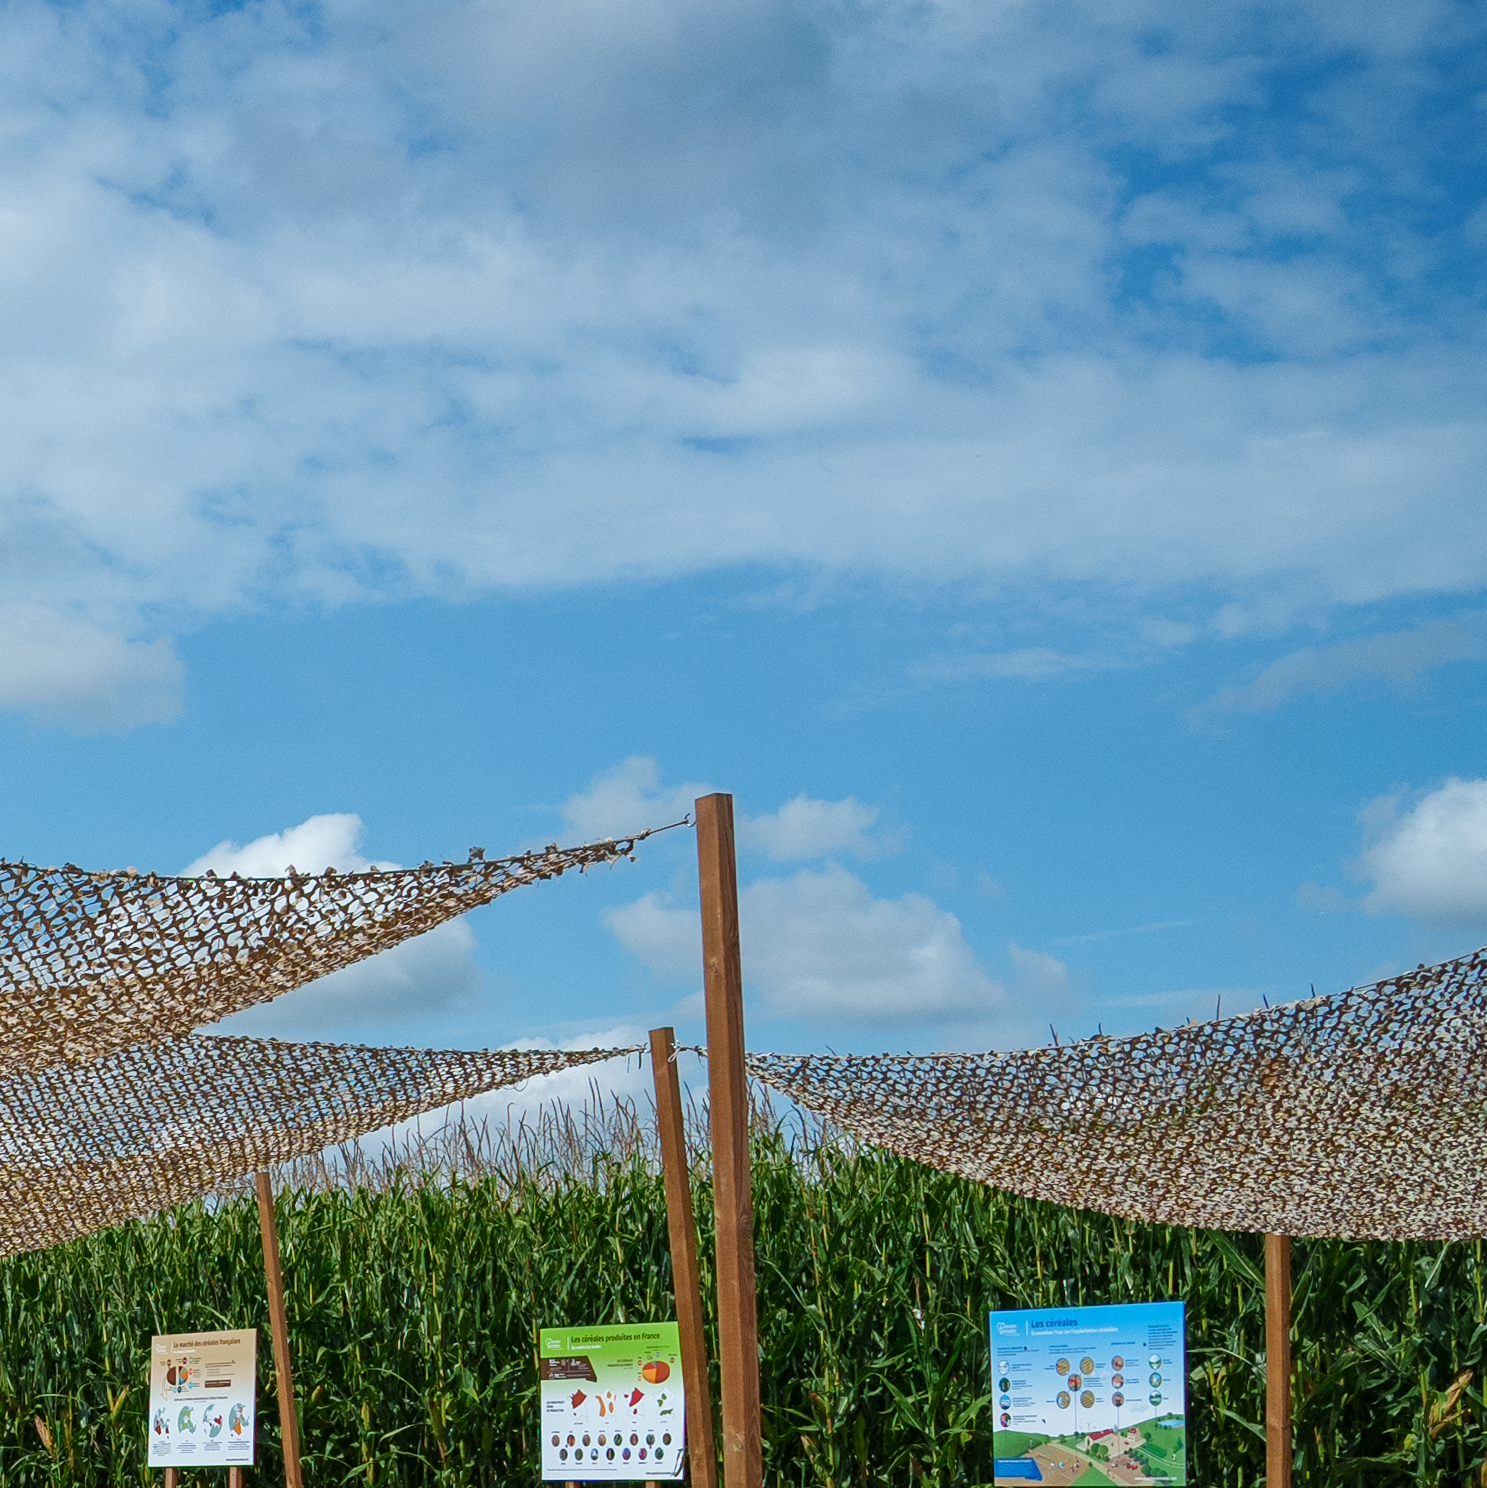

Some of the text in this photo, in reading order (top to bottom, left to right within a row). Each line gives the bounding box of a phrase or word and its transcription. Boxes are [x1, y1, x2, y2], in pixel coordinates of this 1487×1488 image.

[1031, 1318, 1078, 1328] Les céréales
[582, 1334, 604, 1342] céréales
[606, 1333, 632, 1343] produites
[642, 1332, 660, 1340] France
